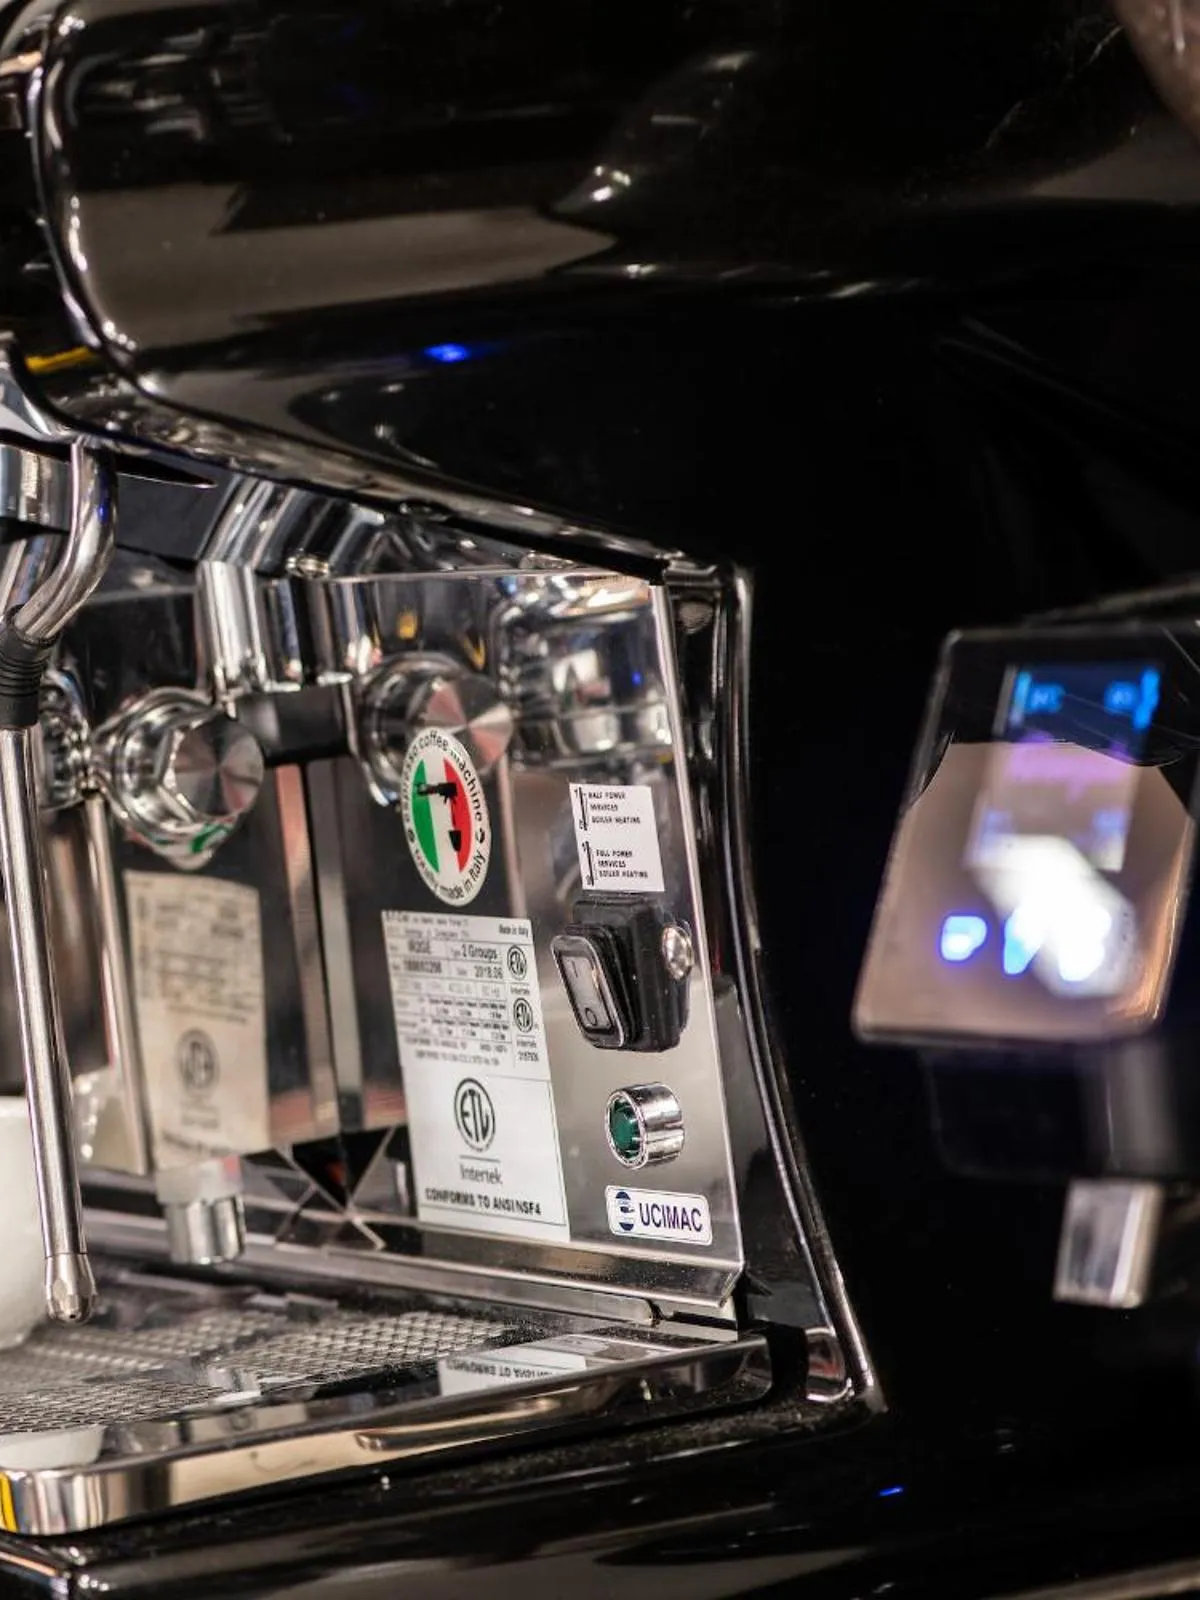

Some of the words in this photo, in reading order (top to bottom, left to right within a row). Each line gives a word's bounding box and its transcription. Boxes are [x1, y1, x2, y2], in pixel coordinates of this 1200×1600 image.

[419, 729, 449, 752] coffee
[450, 748, 483, 823] machine
[468, 849, 486, 882] Italy
[461, 943, 467, 958] 2
[467, 943, 498, 964] Groups
[459, 1163, 503, 1185] Intertek
[425, 1187, 476, 1207] CONFORMS
[477, 1193, 491, 1209] TO
[639, 1202, 703, 1232] UCIMAC
